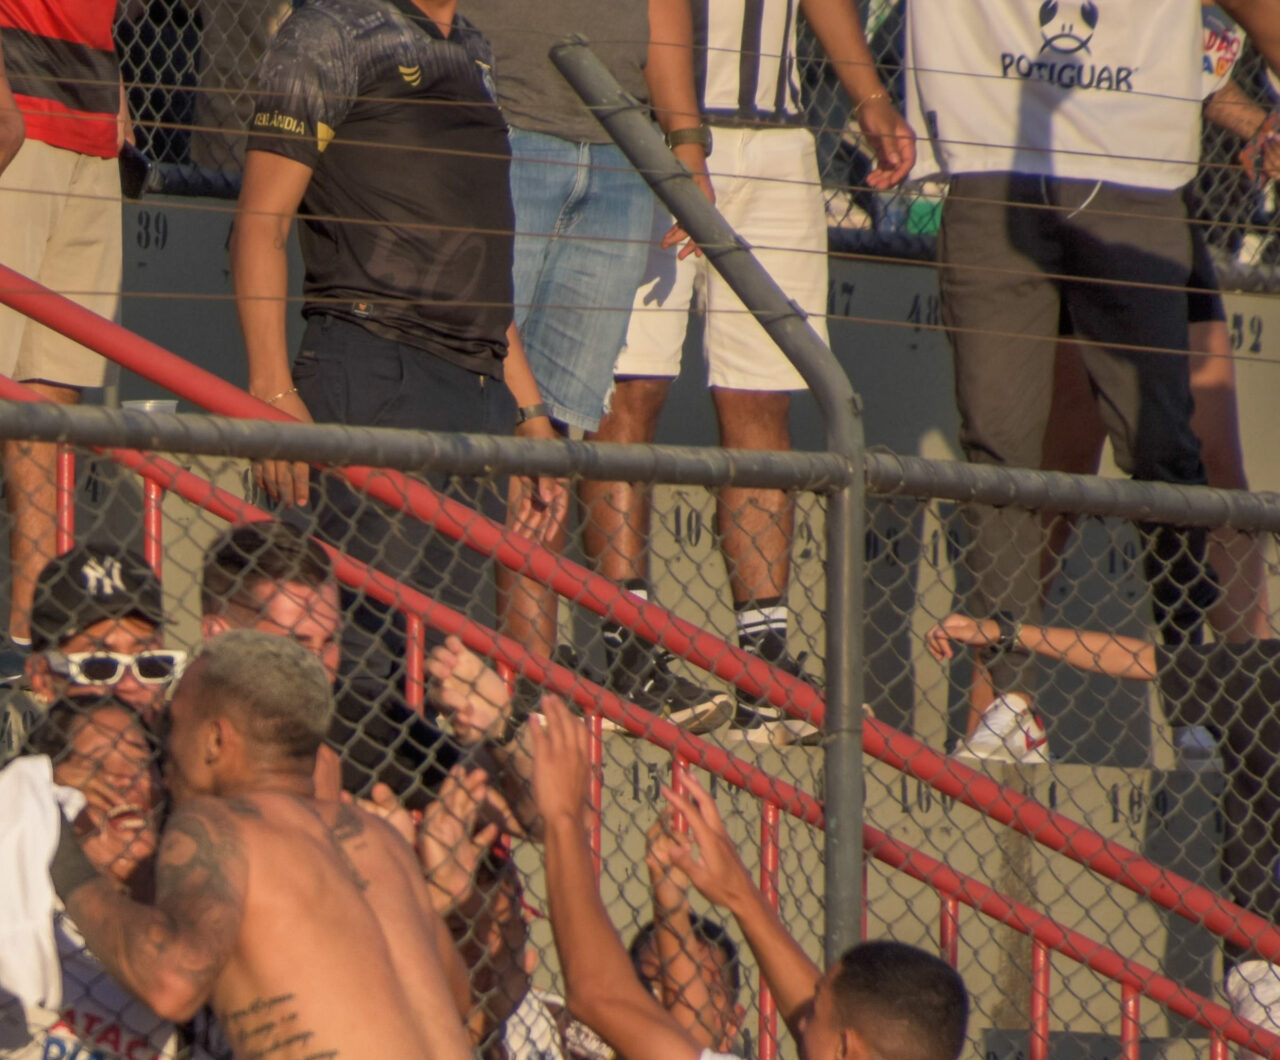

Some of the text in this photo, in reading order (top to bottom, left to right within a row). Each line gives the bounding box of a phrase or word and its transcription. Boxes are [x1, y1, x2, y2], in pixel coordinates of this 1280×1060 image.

[1001, 53, 1134, 92] POTIGUAR
[138, 210, 168, 250] 39
[1230, 312, 1263, 354] 52
